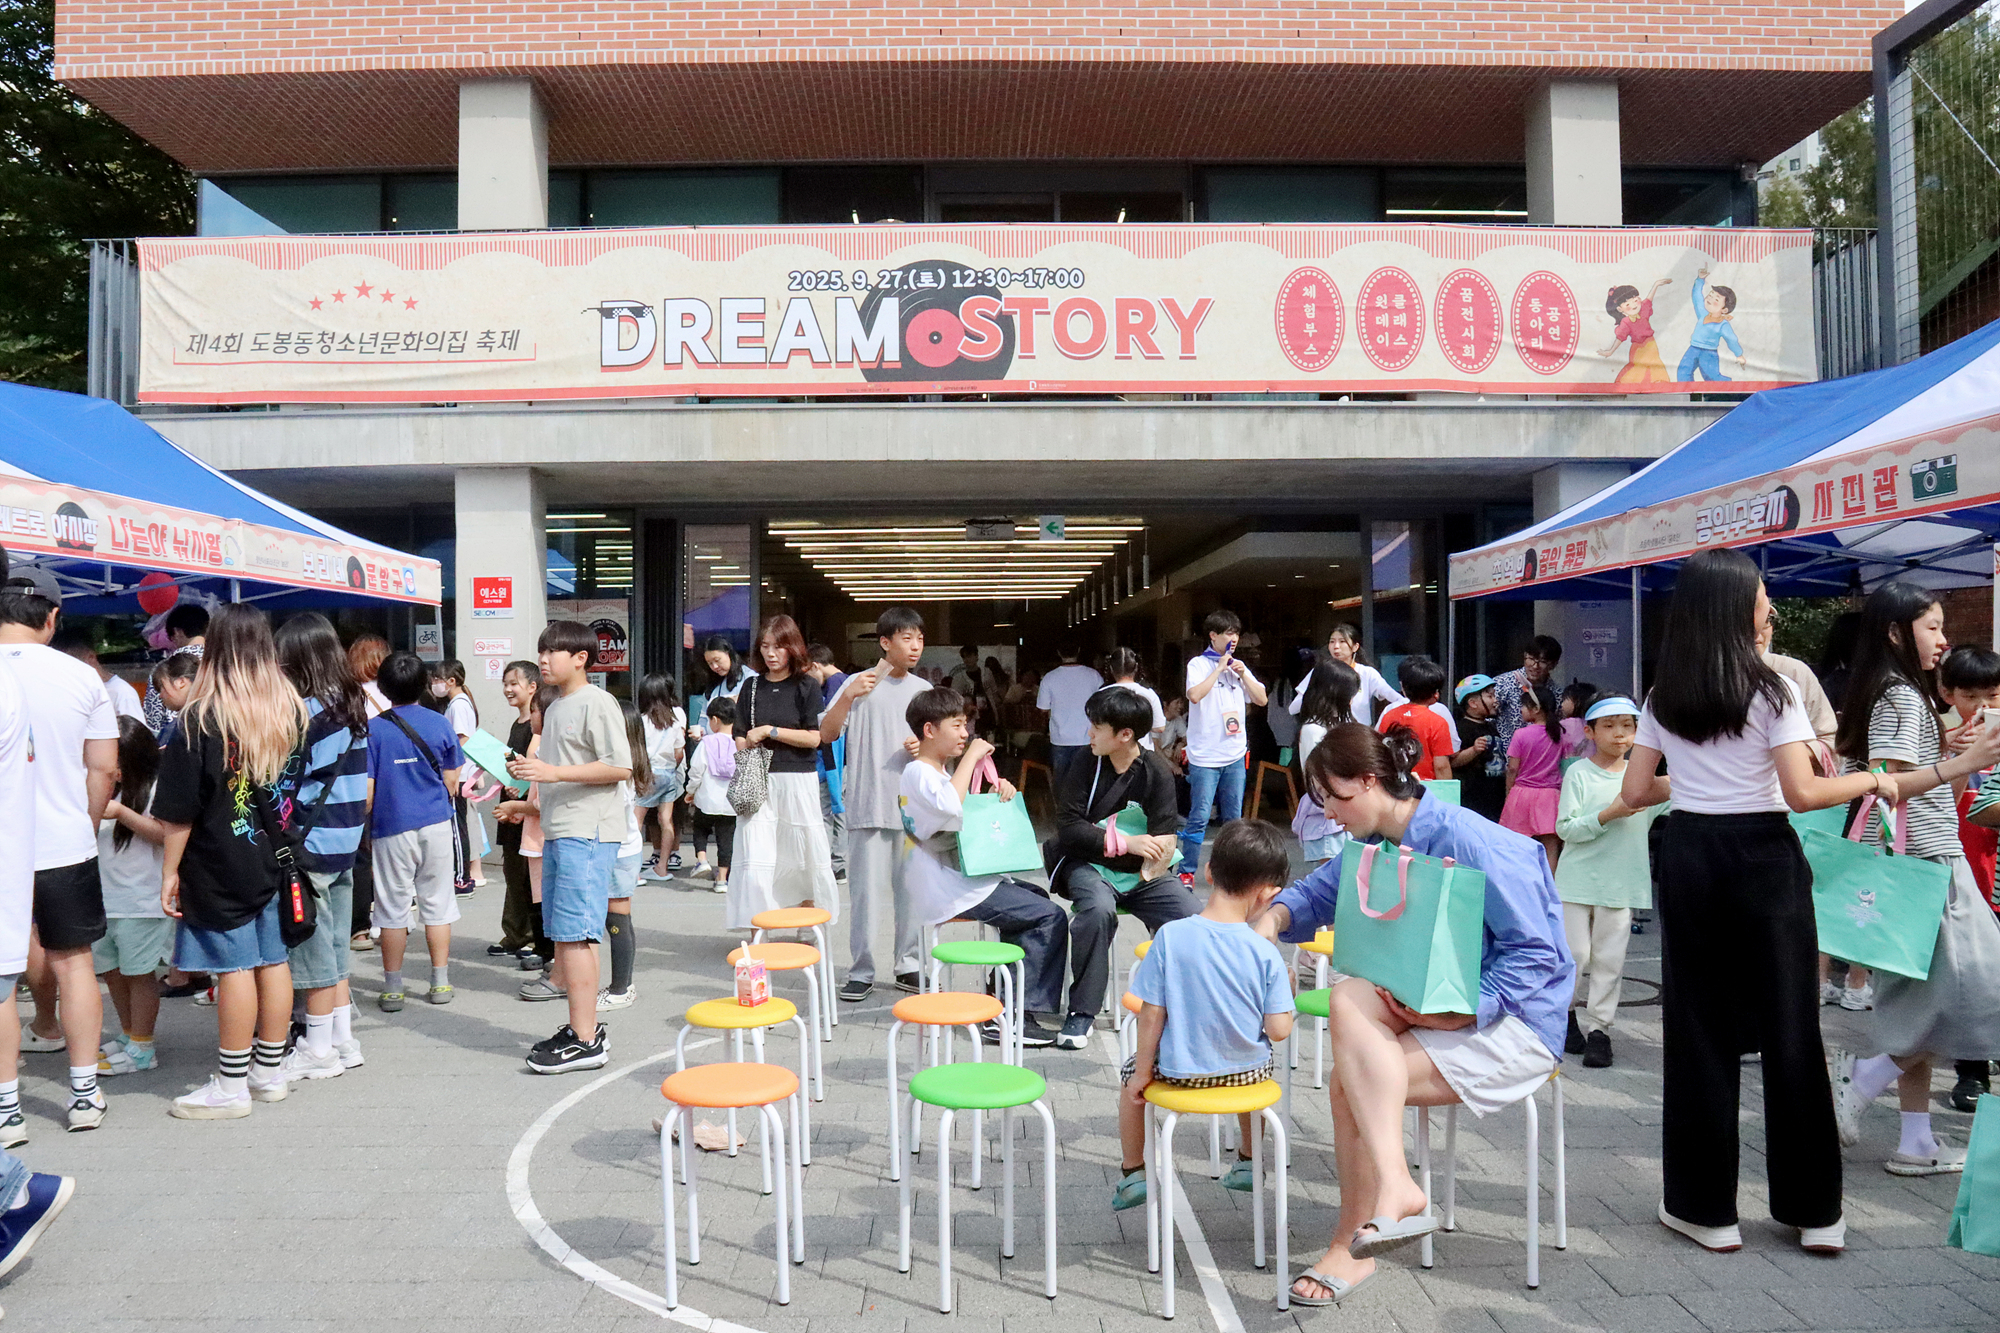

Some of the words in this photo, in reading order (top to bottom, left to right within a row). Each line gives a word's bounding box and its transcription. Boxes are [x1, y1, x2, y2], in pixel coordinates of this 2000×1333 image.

[788, 270, 849, 291] 2025.
[852, 270, 872, 291] 9.
[878, 268, 946, 290] 27.(토)
[952, 267, 1085, 290] 12:30~17:00
[601, 297, 902, 370] DREAM
[959, 295, 1215, 361] STORY
[1302, 284, 1319, 355] 체험부스
[1375, 293, 1389, 347] 원데이
[1392, 293, 1409, 346] 클래스
[1460, 287, 1475, 359] 꿈전시회
[1529, 298, 1544, 350] 동아리
[1546, 307, 1561, 341] 공연
[185, 332, 242, 355] 제4회
[250, 330, 469, 355] 도봉동청소년문화의집
[476, 329, 521, 353] 축제
[1811, 464, 1900, 523] 사진관
[107, 515, 168, 558] 나는야
[172, 525, 223, 567] 낚시왕
[1539, 545, 1562, 577] 공익
[365, 562, 403, 593] 문방구
[480, 587, 507, 599] 에스원
[598, 651, 626, 664] ORY
[599, 639, 628, 651] EAM
